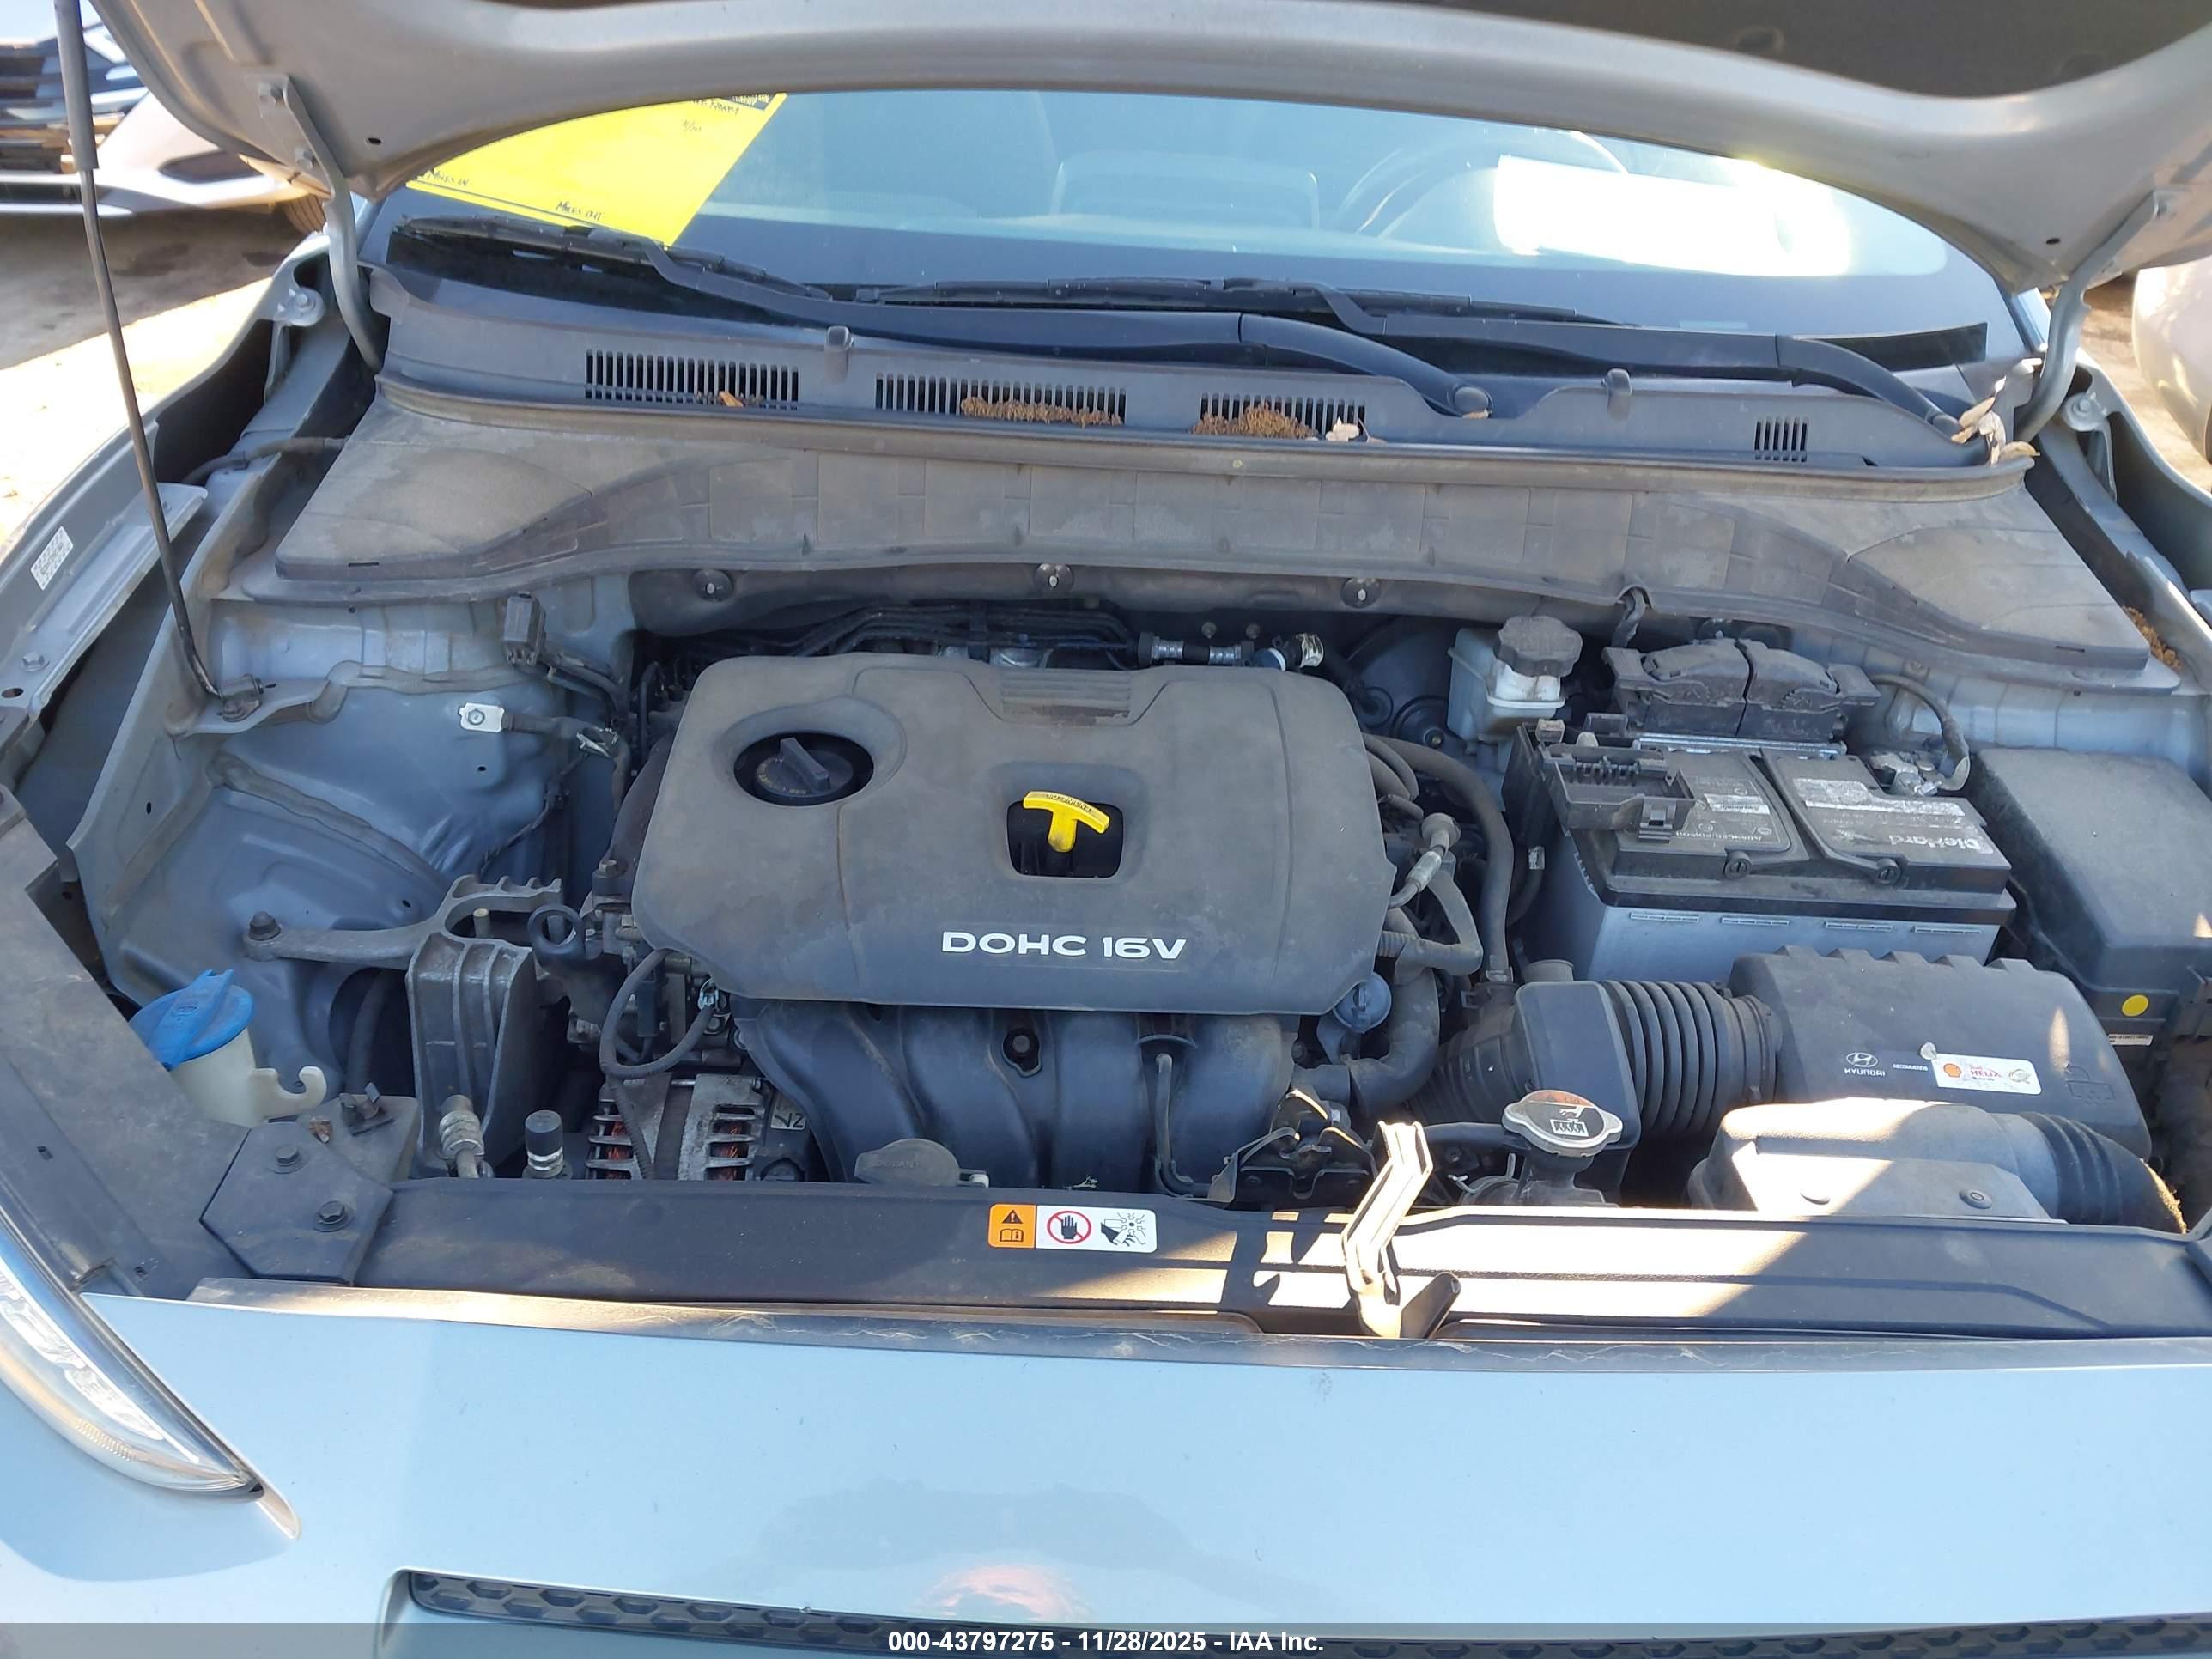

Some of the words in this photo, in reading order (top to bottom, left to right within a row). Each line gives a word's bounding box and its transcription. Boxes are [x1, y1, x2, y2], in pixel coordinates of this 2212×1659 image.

[941, 931, 1087, 957] DOHC
[1102, 936, 1187, 960] 16V
[1844, 1067, 1886, 1078] HYUNDAI
